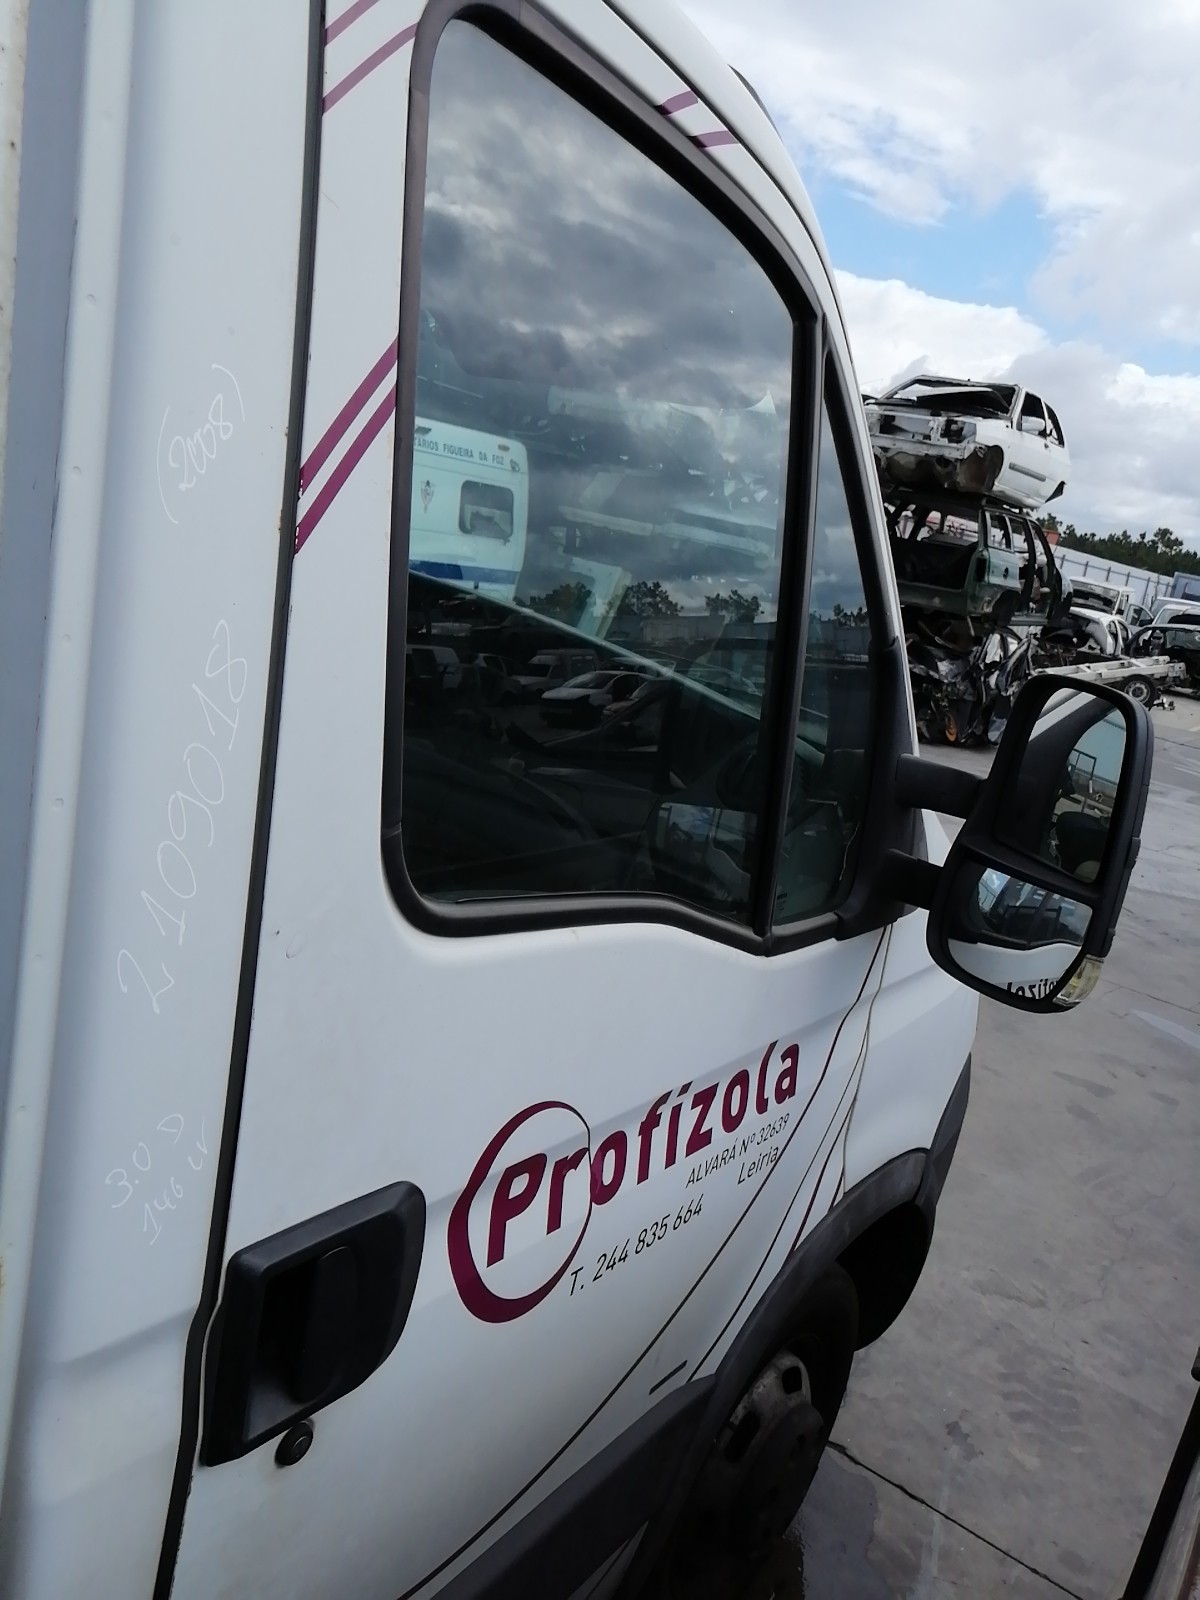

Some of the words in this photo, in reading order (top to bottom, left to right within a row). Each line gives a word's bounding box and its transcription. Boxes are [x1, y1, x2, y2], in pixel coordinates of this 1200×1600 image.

[157, 363, 245, 524] (2008)
[443, 443, 474, 459] FIGUEIRA
[478, 451, 488, 463] DA
[492, 454, 505, 466] FOZ
[105, 1142, 151, 1208] 3.0
[156, 1114, 185, 1145] D
[486, 1040, 800, 1268] Profizola
[685, 1137, 738, 1189] ALVARÁ
[756, 1112, 790, 1146] 32639
[737, 1146, 779, 1185] Leiria
[143, 1177, 184, 1245] 146
[569, 1266, 584, 1296] T.
[592, 1238, 630, 1282] 244
[635, 1213, 671, 1254] 835
[672, 1193, 704, 1231] 664
